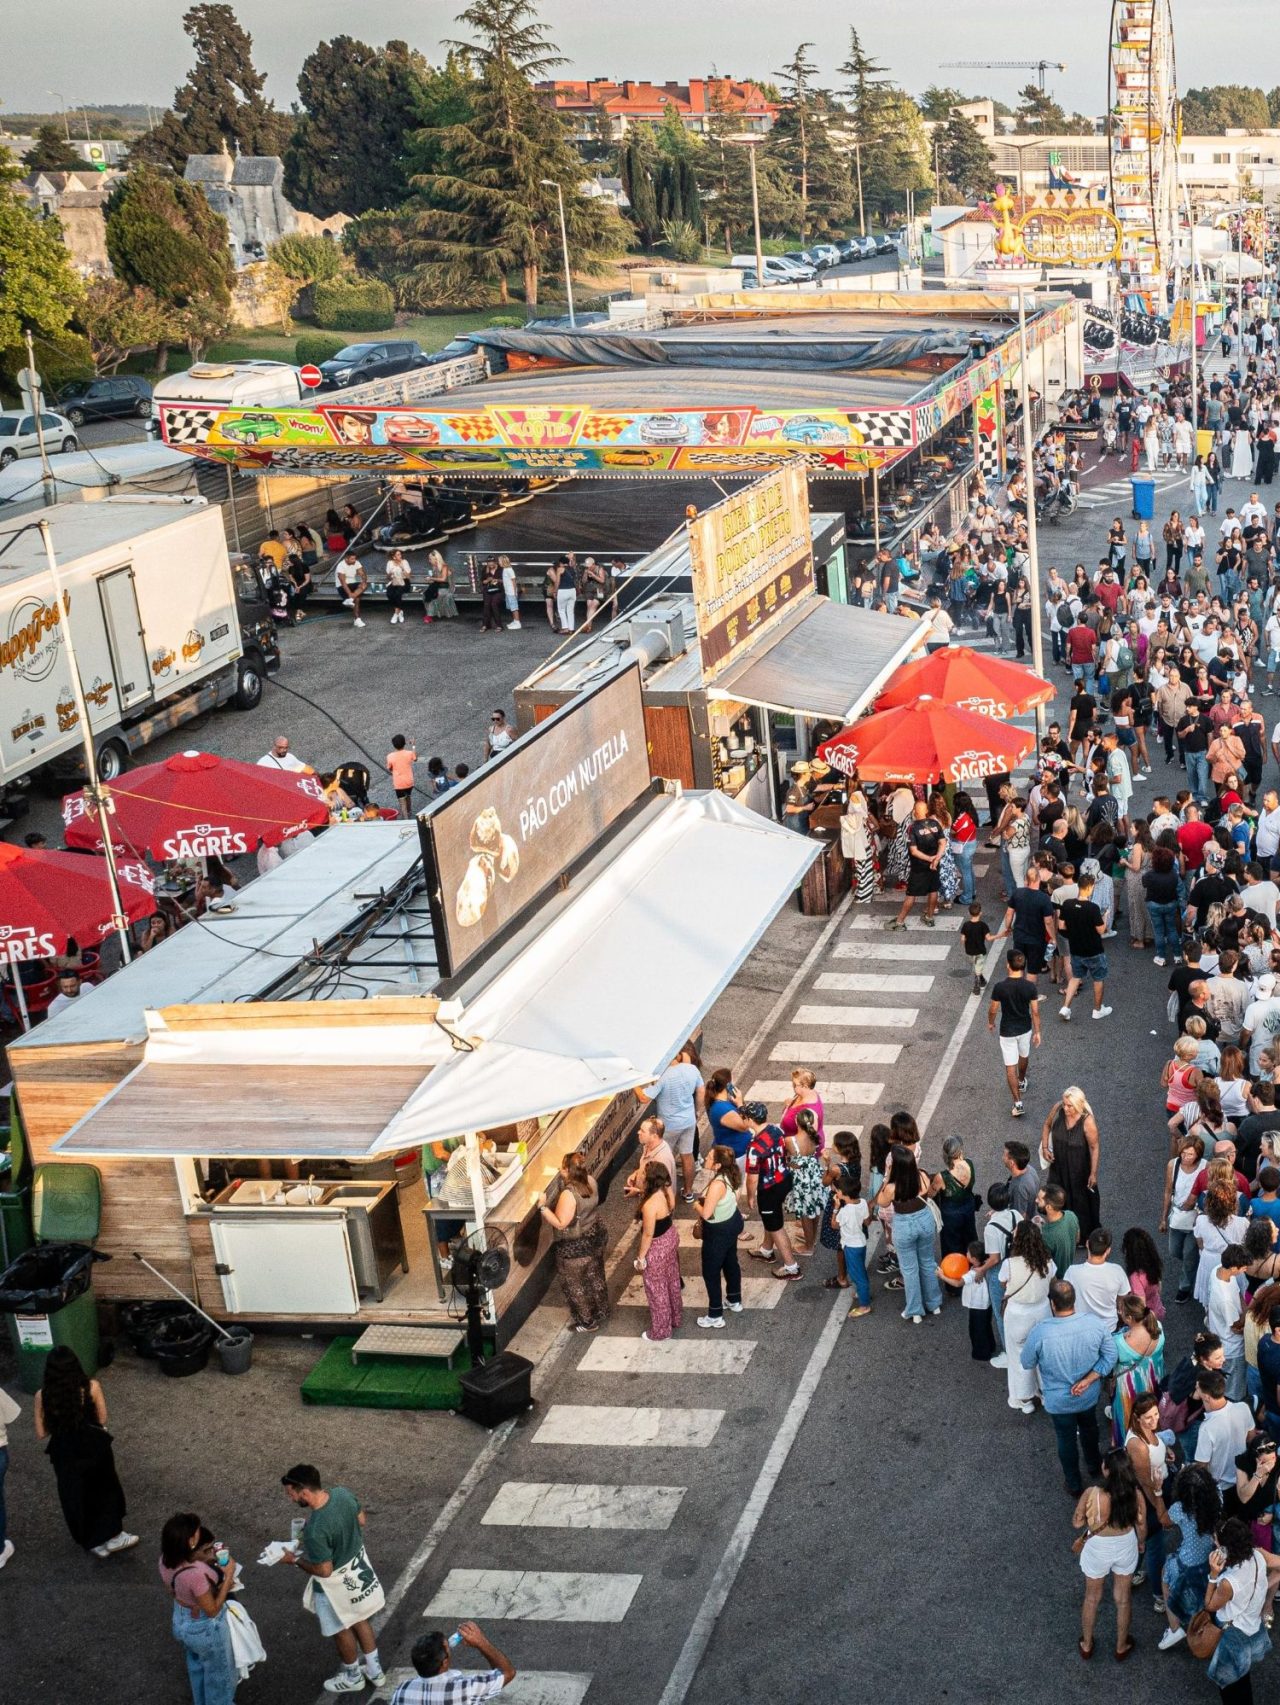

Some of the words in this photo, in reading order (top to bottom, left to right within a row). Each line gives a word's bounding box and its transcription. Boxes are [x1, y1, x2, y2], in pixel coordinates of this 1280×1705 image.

[287, 417, 325, 436] Vroom!
[716, 532, 756, 582] PORCO
[757, 509, 792, 554] PRETO
[14, 665, 26, 680] FOR
[27, 651, 44, 669] HAPPY
[969, 702, 1007, 720] GRES
[824, 747, 857, 777] SAGRES
[950, 754, 1007, 782] SAGRES
[520, 798, 548, 841] PÃO
[549, 774, 578, 815] COM
[579, 730, 629, 792] NUTELLA
[163, 832, 248, 860] SAGRES
